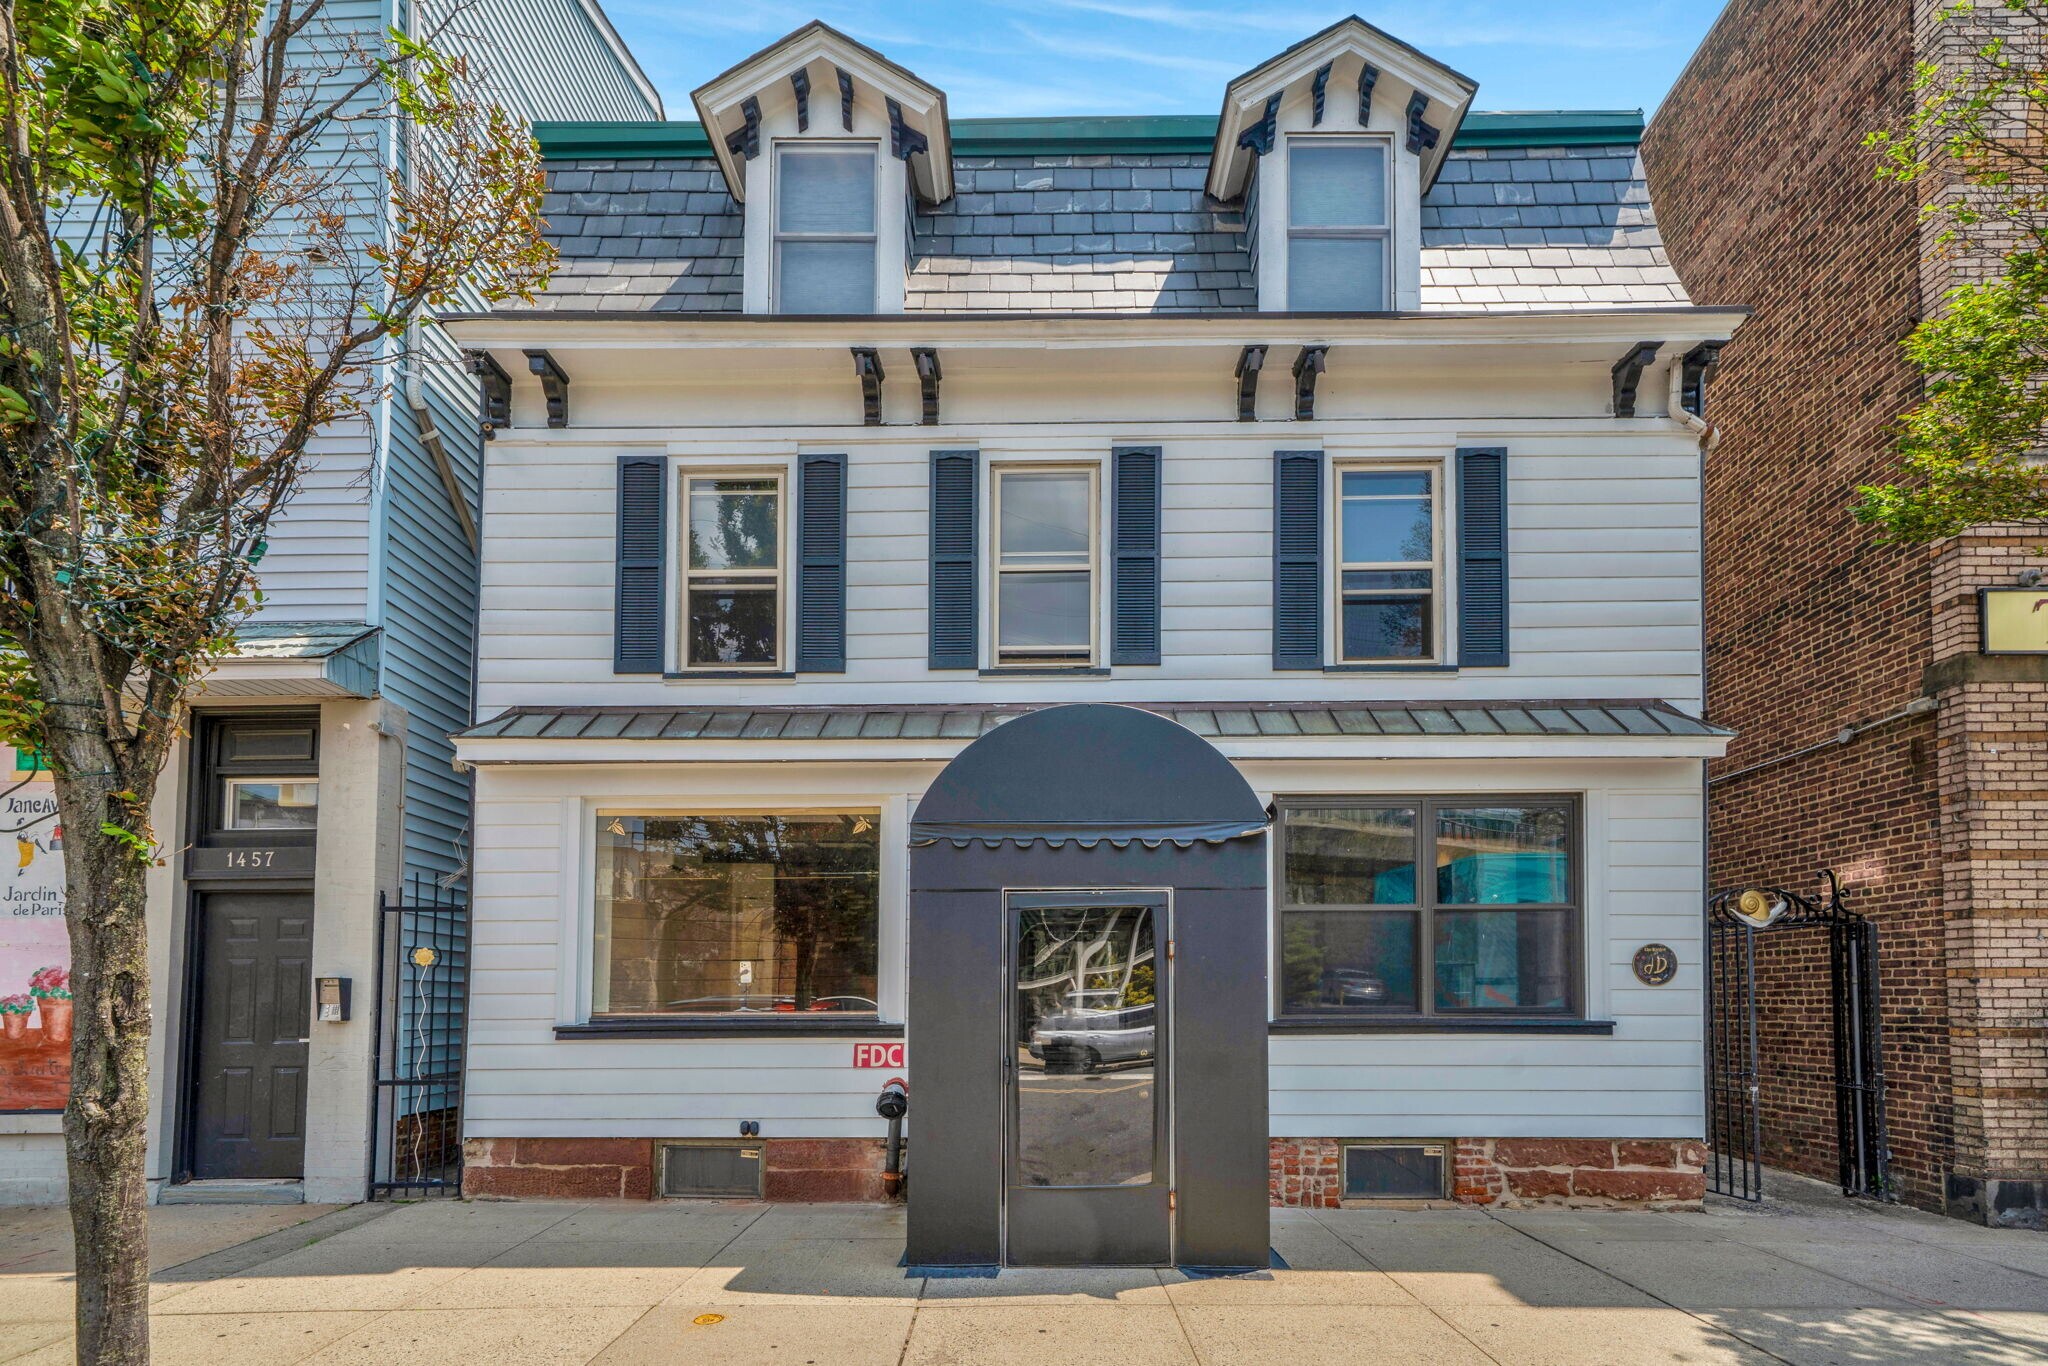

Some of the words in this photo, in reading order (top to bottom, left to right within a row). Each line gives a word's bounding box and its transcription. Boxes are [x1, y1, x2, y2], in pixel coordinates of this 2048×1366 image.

[227, 851, 275, 867] 1457
[2, 885, 57, 902] Jardin
[13, 903, 29, 916] de
[31, 903, 65, 916] Pari
[857, 1044, 902, 1067] FDC
